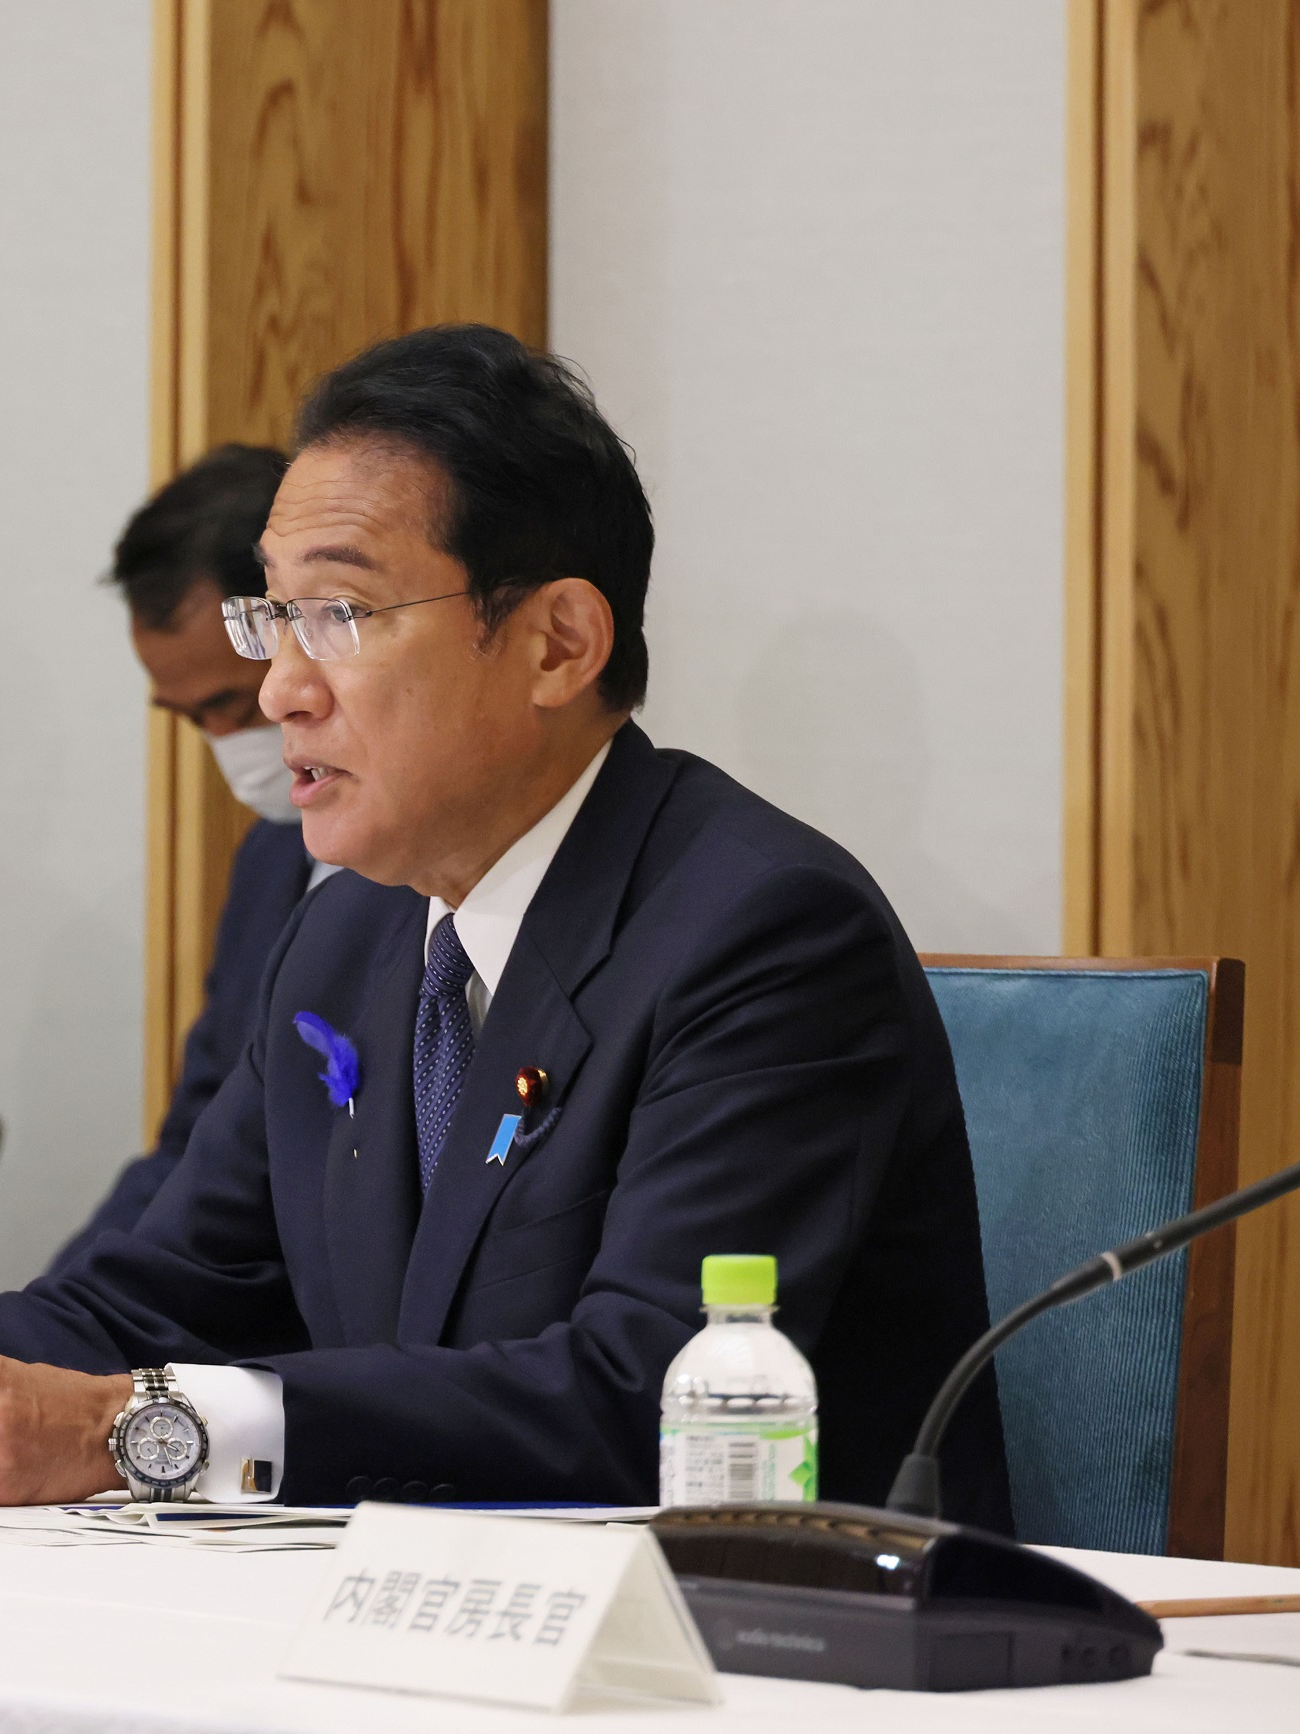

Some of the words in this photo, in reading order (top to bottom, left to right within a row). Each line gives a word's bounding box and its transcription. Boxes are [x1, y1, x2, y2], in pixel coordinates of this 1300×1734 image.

[323, 1568, 587, 1647] 内閣官房長官
